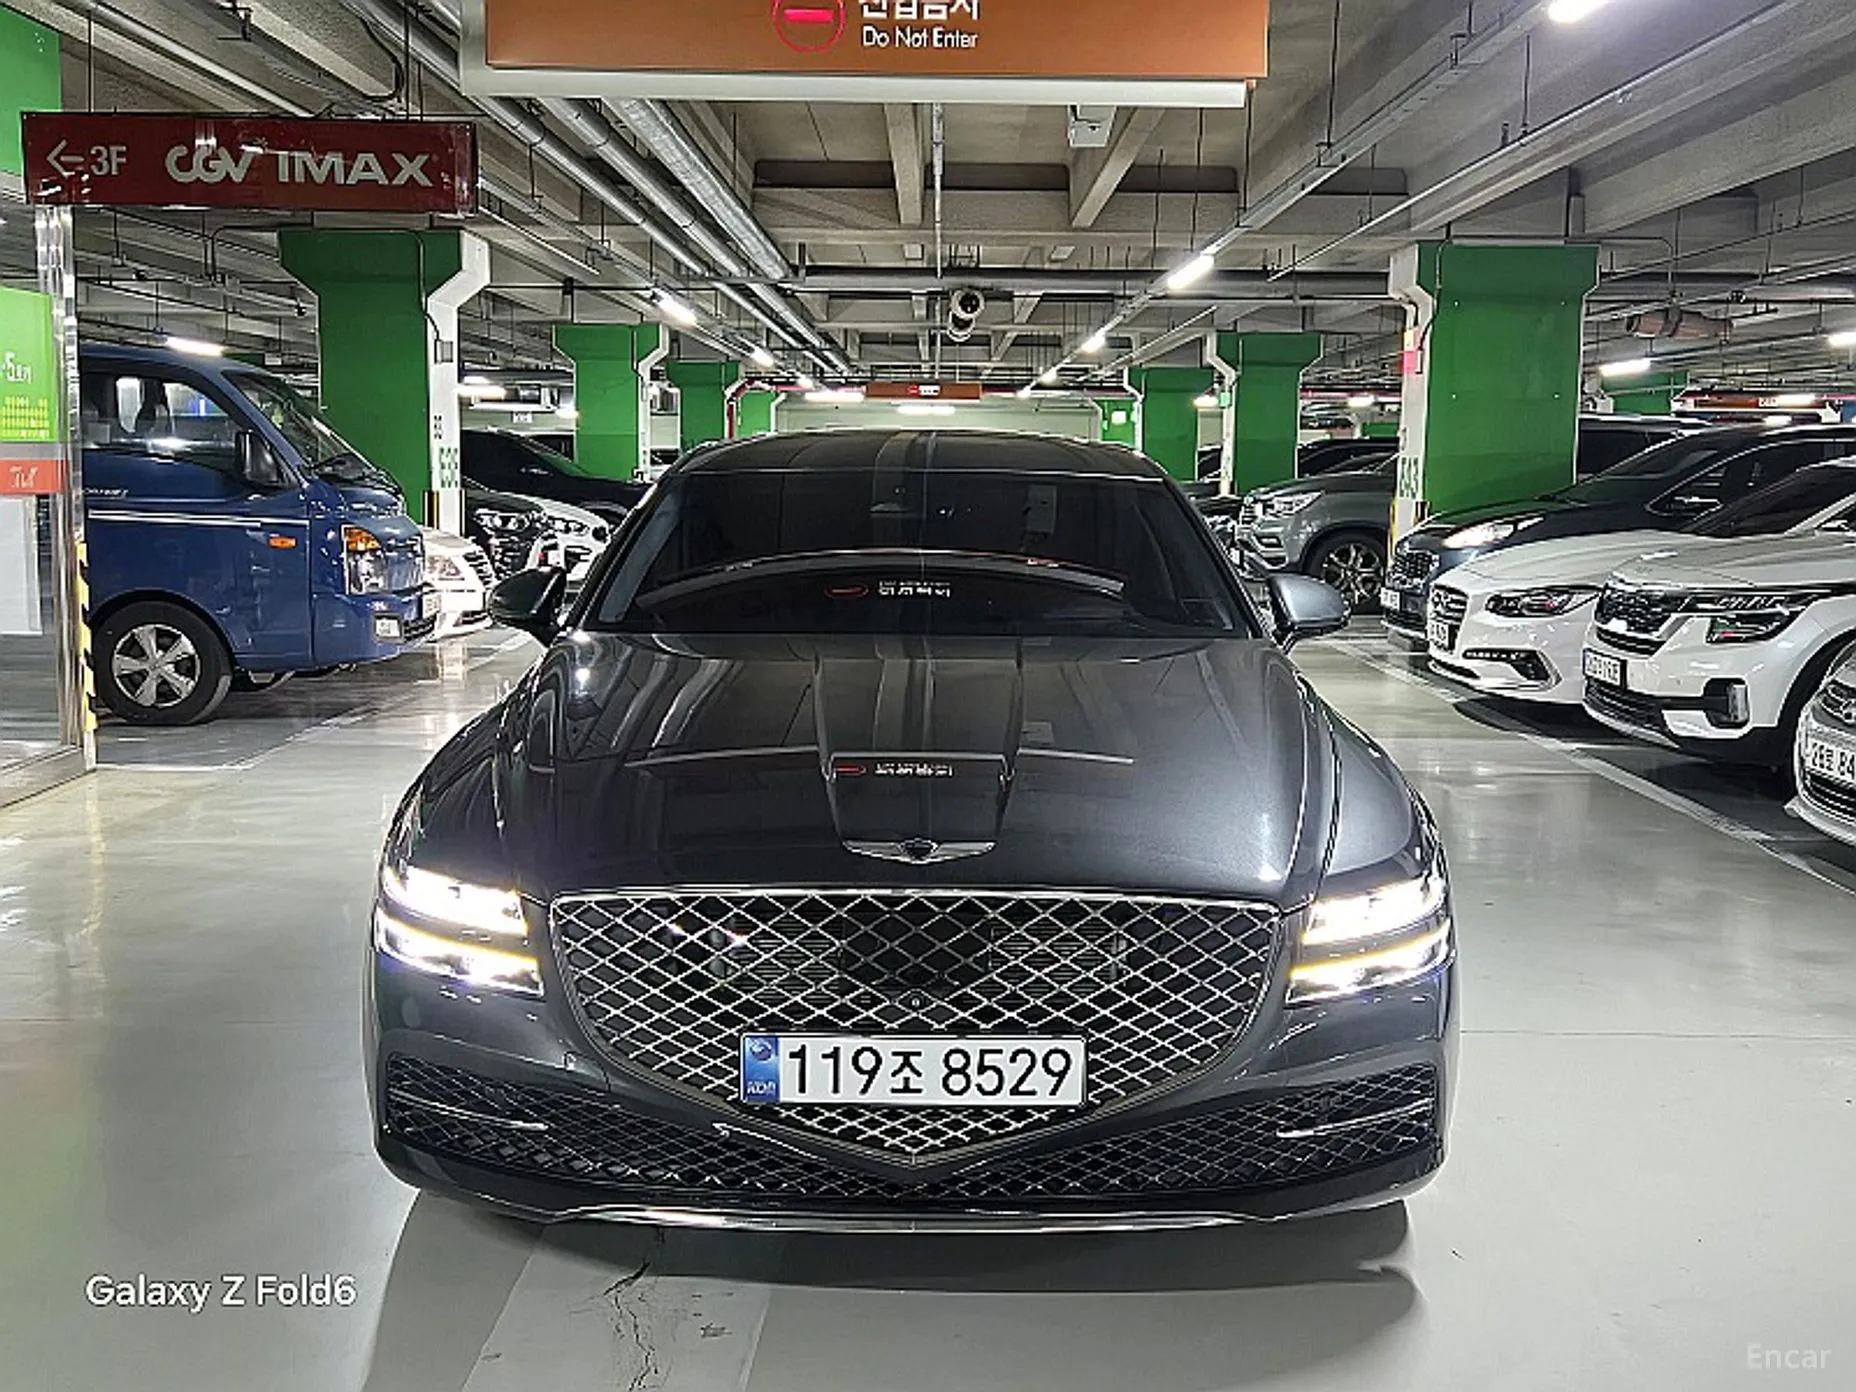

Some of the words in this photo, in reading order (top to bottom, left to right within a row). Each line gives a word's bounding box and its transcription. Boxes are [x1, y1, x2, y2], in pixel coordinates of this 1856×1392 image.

[862, 24, 890, 48] Do
[895, 24, 928, 48] Not
[932, 25, 979, 48] Enter
[90, 145, 127, 176] 3F
[164, 144, 255, 184] CGV
[276, 150, 433, 188] IMAX
[788, 1044, 923, 1096] 119조
[941, 1047, 1072, 1097] 8529
